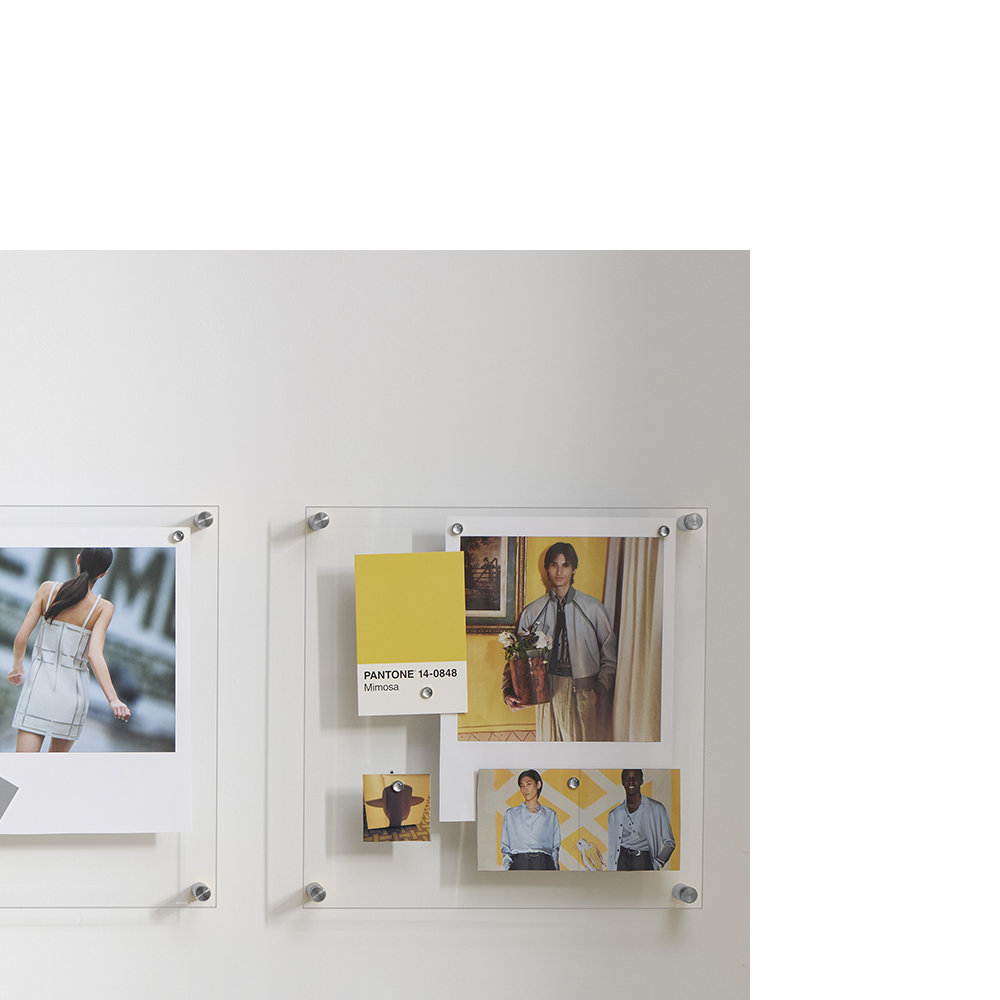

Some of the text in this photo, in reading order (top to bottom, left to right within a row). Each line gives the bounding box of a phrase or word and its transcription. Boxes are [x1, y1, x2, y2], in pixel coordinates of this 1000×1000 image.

[363, 668, 458, 680] PANTONE 14-0848
[363, 683, 400, 692] Mimosa
